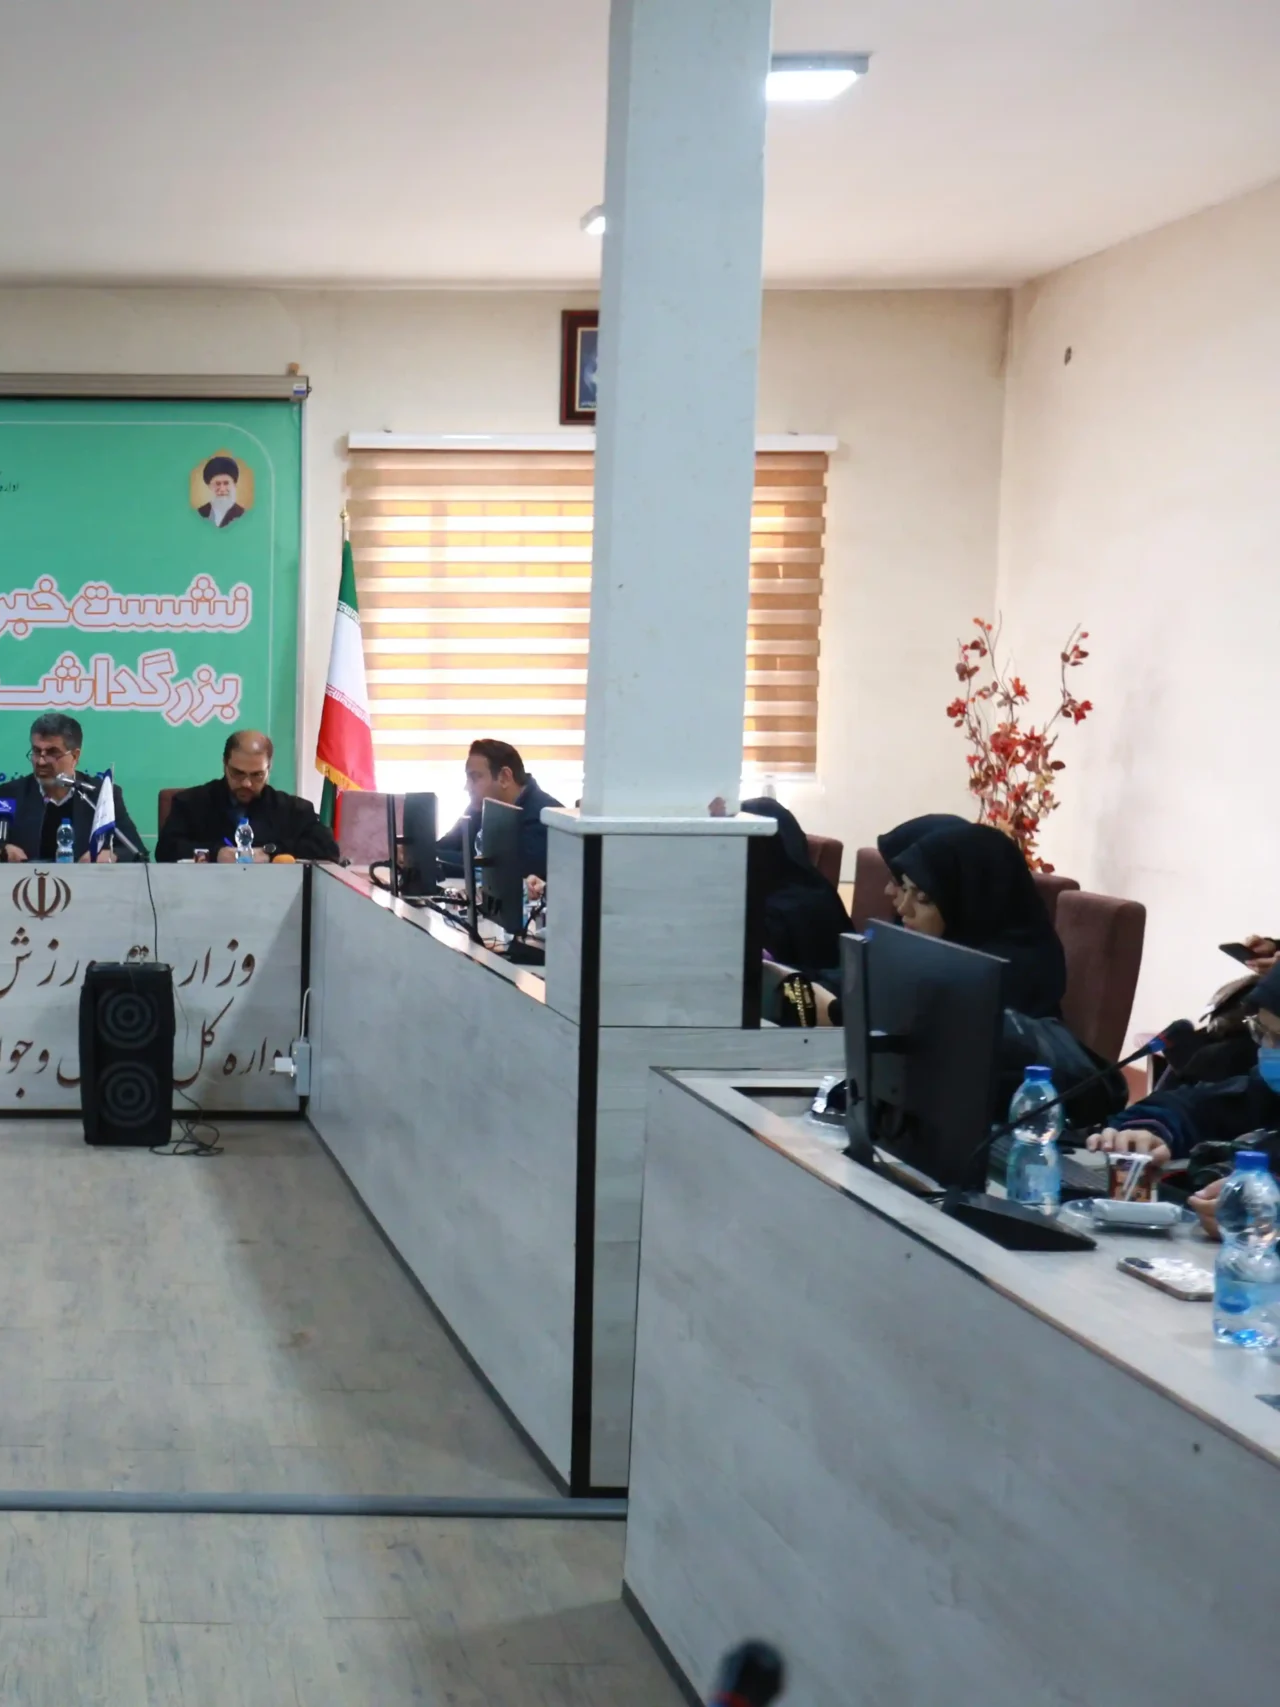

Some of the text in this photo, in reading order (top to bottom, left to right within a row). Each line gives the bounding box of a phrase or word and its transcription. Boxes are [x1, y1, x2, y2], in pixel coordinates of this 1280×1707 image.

[69, 575, 251, 631] نشست
[34, 1048, 51, 1075] و
[172, 996, 235, 1091] کل
